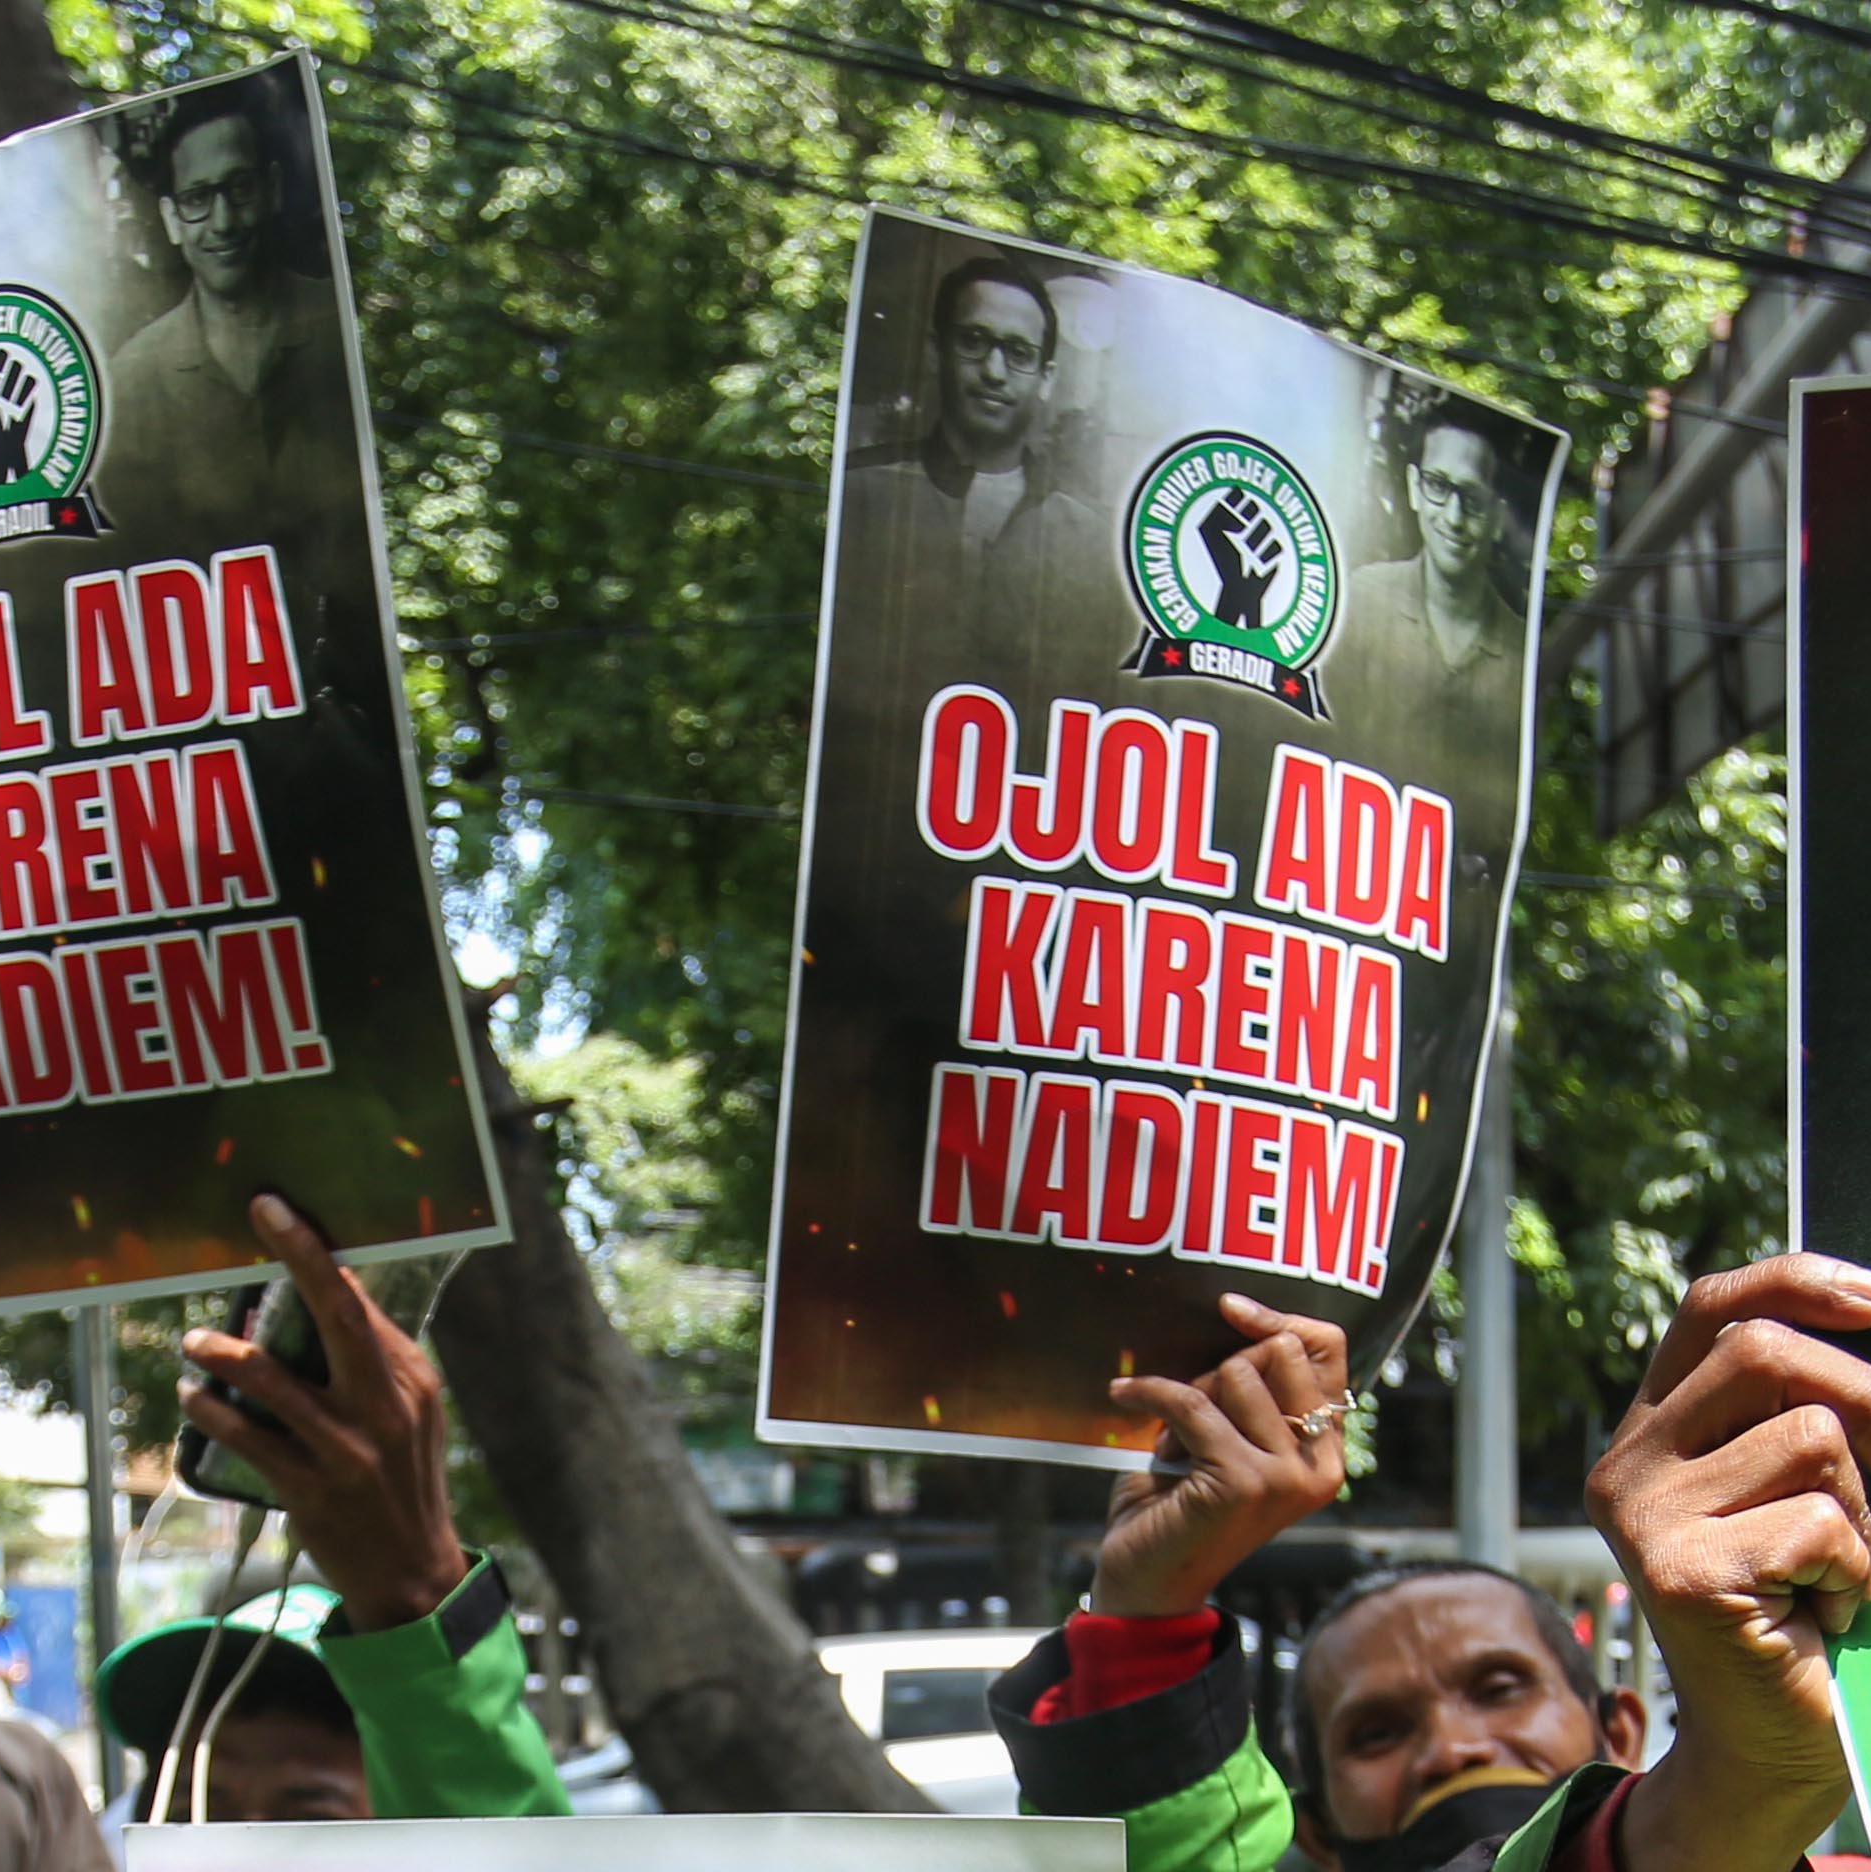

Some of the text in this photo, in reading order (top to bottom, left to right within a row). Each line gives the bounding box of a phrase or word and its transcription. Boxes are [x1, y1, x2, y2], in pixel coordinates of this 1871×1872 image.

[20, 311, 77, 375] UNTUK
[64, 544, 305, 748] ADA
[1142, 451, 1326, 659] GERAKAN DRIVER GOJEK UNTUK KEADILAN
[1189, 642, 1276, 693] GERADIL
[916, 684, 1453, 964] OJOL ADA
[960, 875, 1403, 1123] KARENA
[920, 1062, 1405, 1300] NADIEM!
